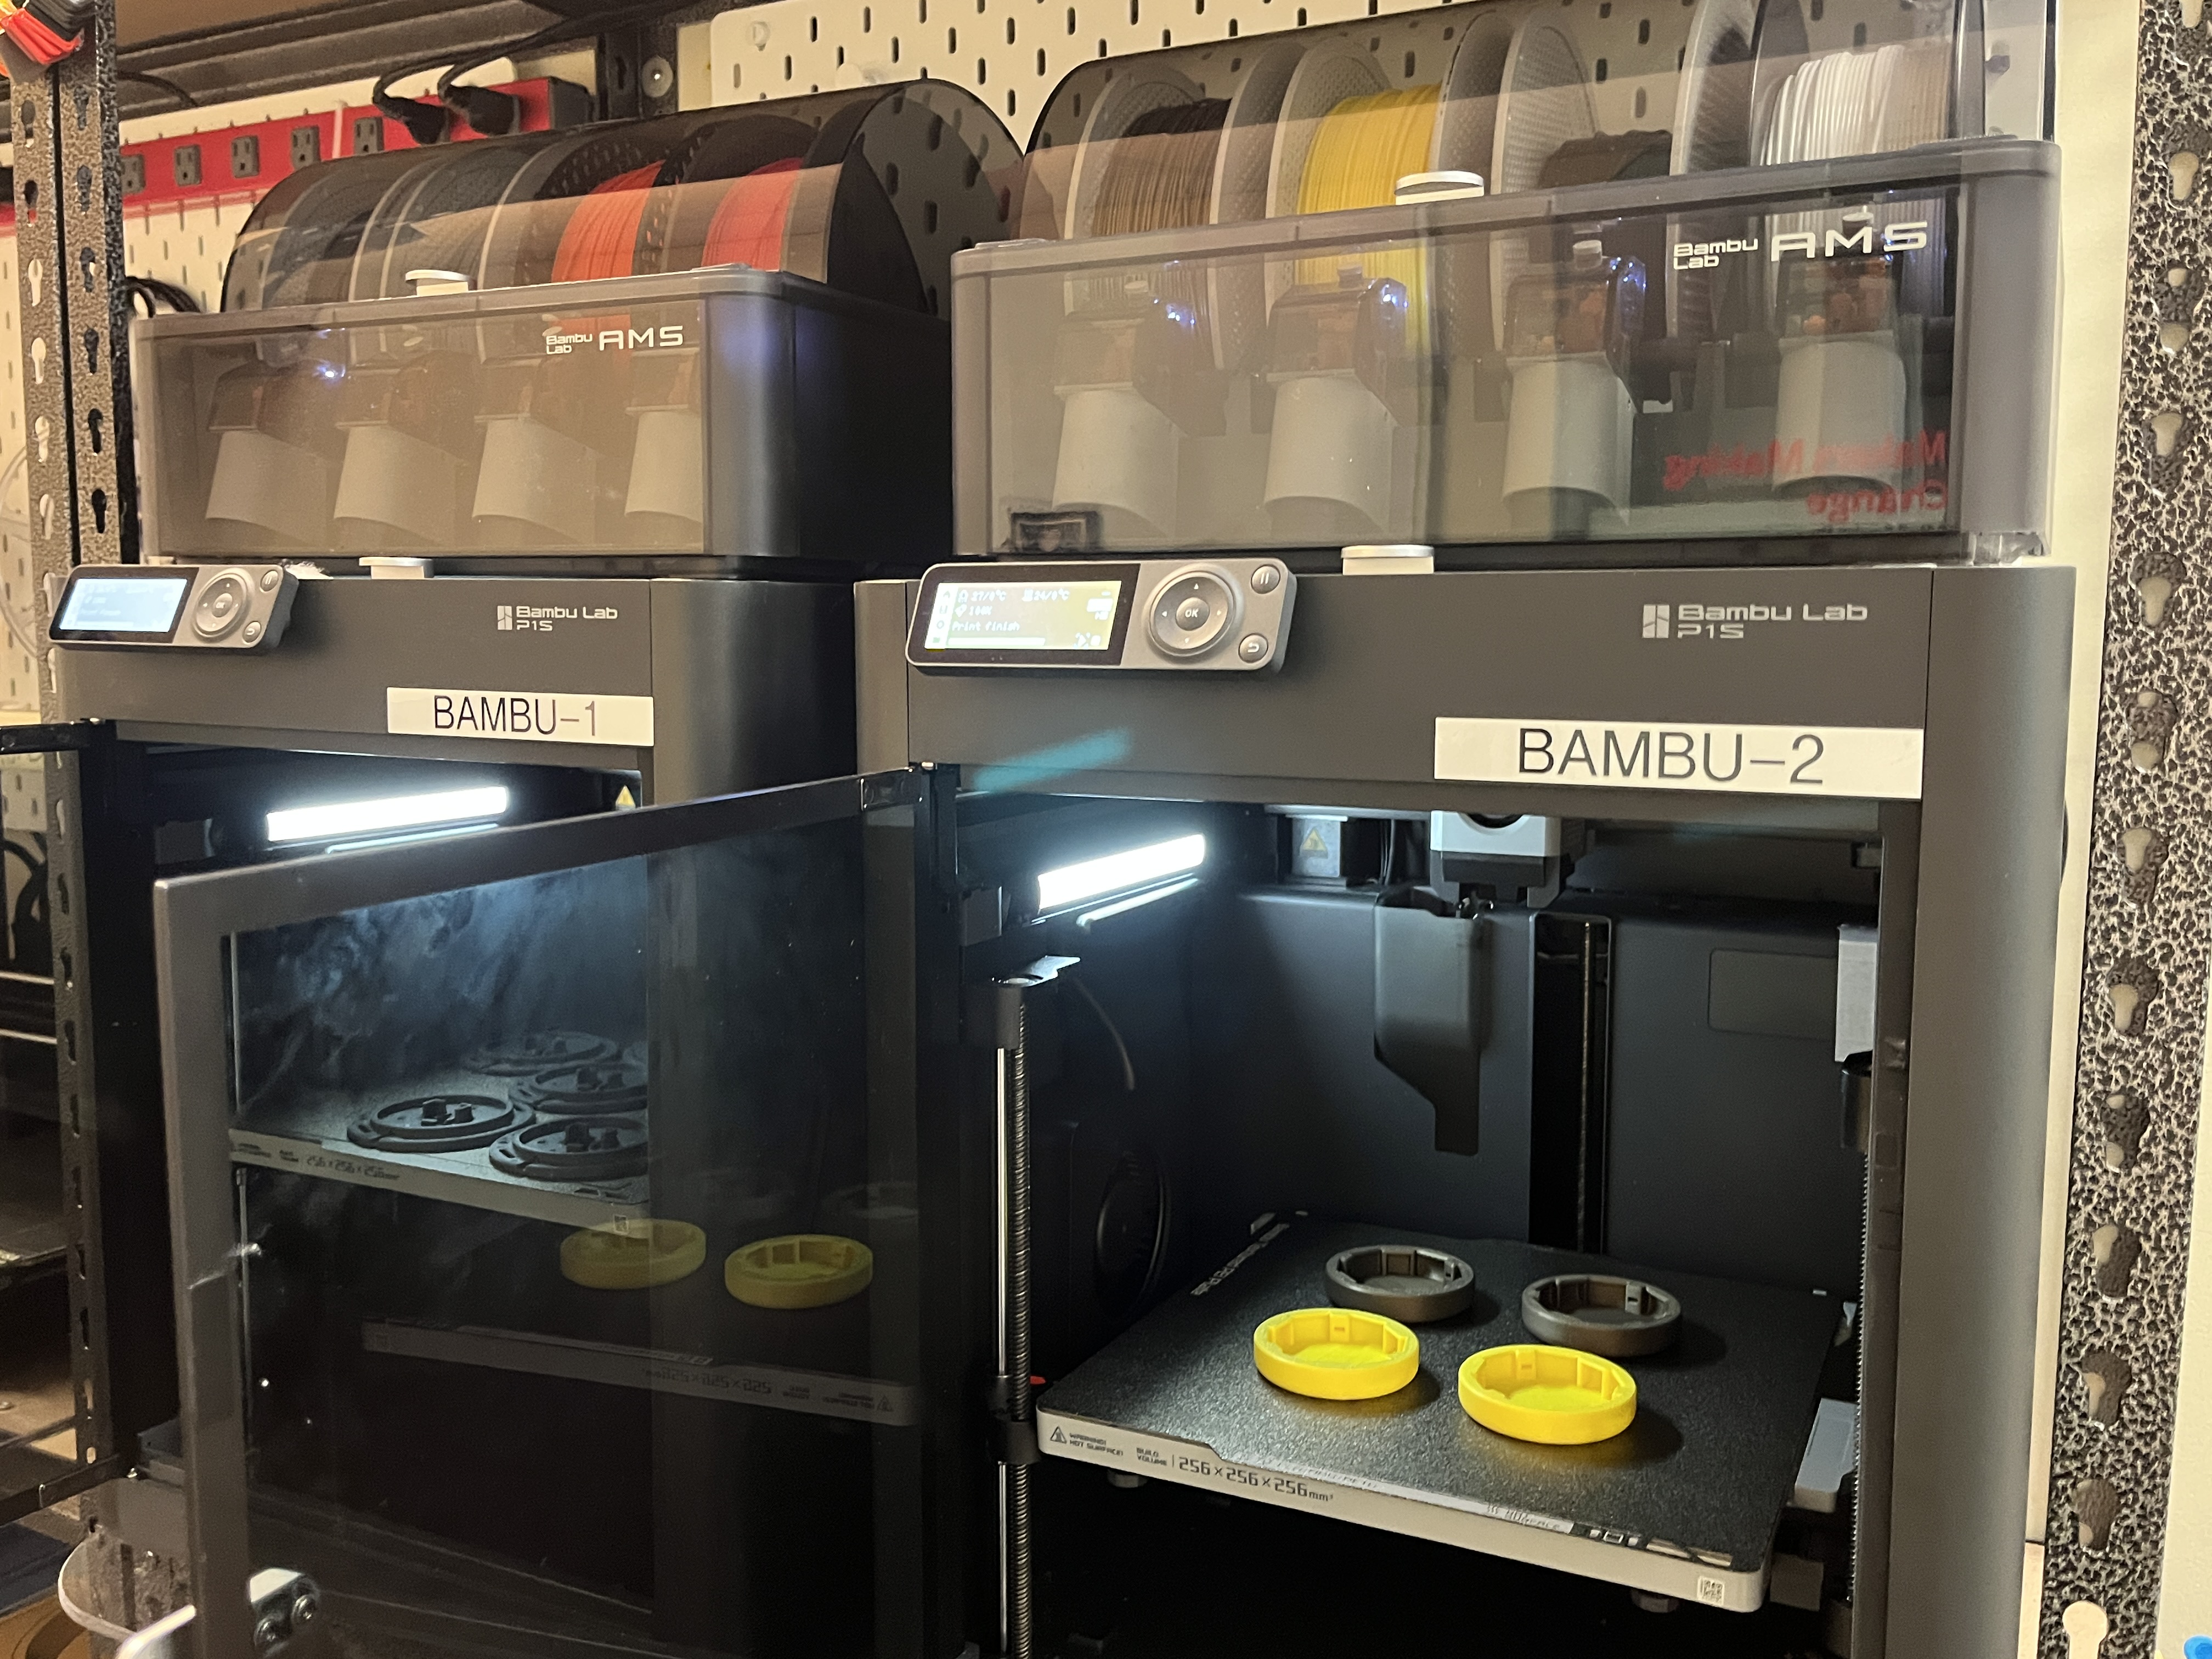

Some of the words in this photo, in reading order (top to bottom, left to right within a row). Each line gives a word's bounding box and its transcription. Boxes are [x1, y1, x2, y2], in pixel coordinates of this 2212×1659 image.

[1673, 238, 1758, 257] Bambu
[1770, 222, 1928, 262] AMS
[1673, 256, 1719, 270] Lab
[546, 334, 593, 345] Bambu
[599, 325, 683, 351] AMS
[546, 345, 572, 354] Lab
[516, 606, 578, 618] Bambu
[583, 606, 618, 619] Lab
[1184, 608, 1199, 618] OK
[1678, 604, 1792, 621] Bambu
[1802, 603, 1868, 621] Lab
[516, 619, 553, 631] P1S
[952, 621, 981, 632] Print
[1677, 623, 1744, 639] P1S
[434, 695, 596, 736] BAMBU-1
[1518, 727, 1825, 786] BAMBU-2
